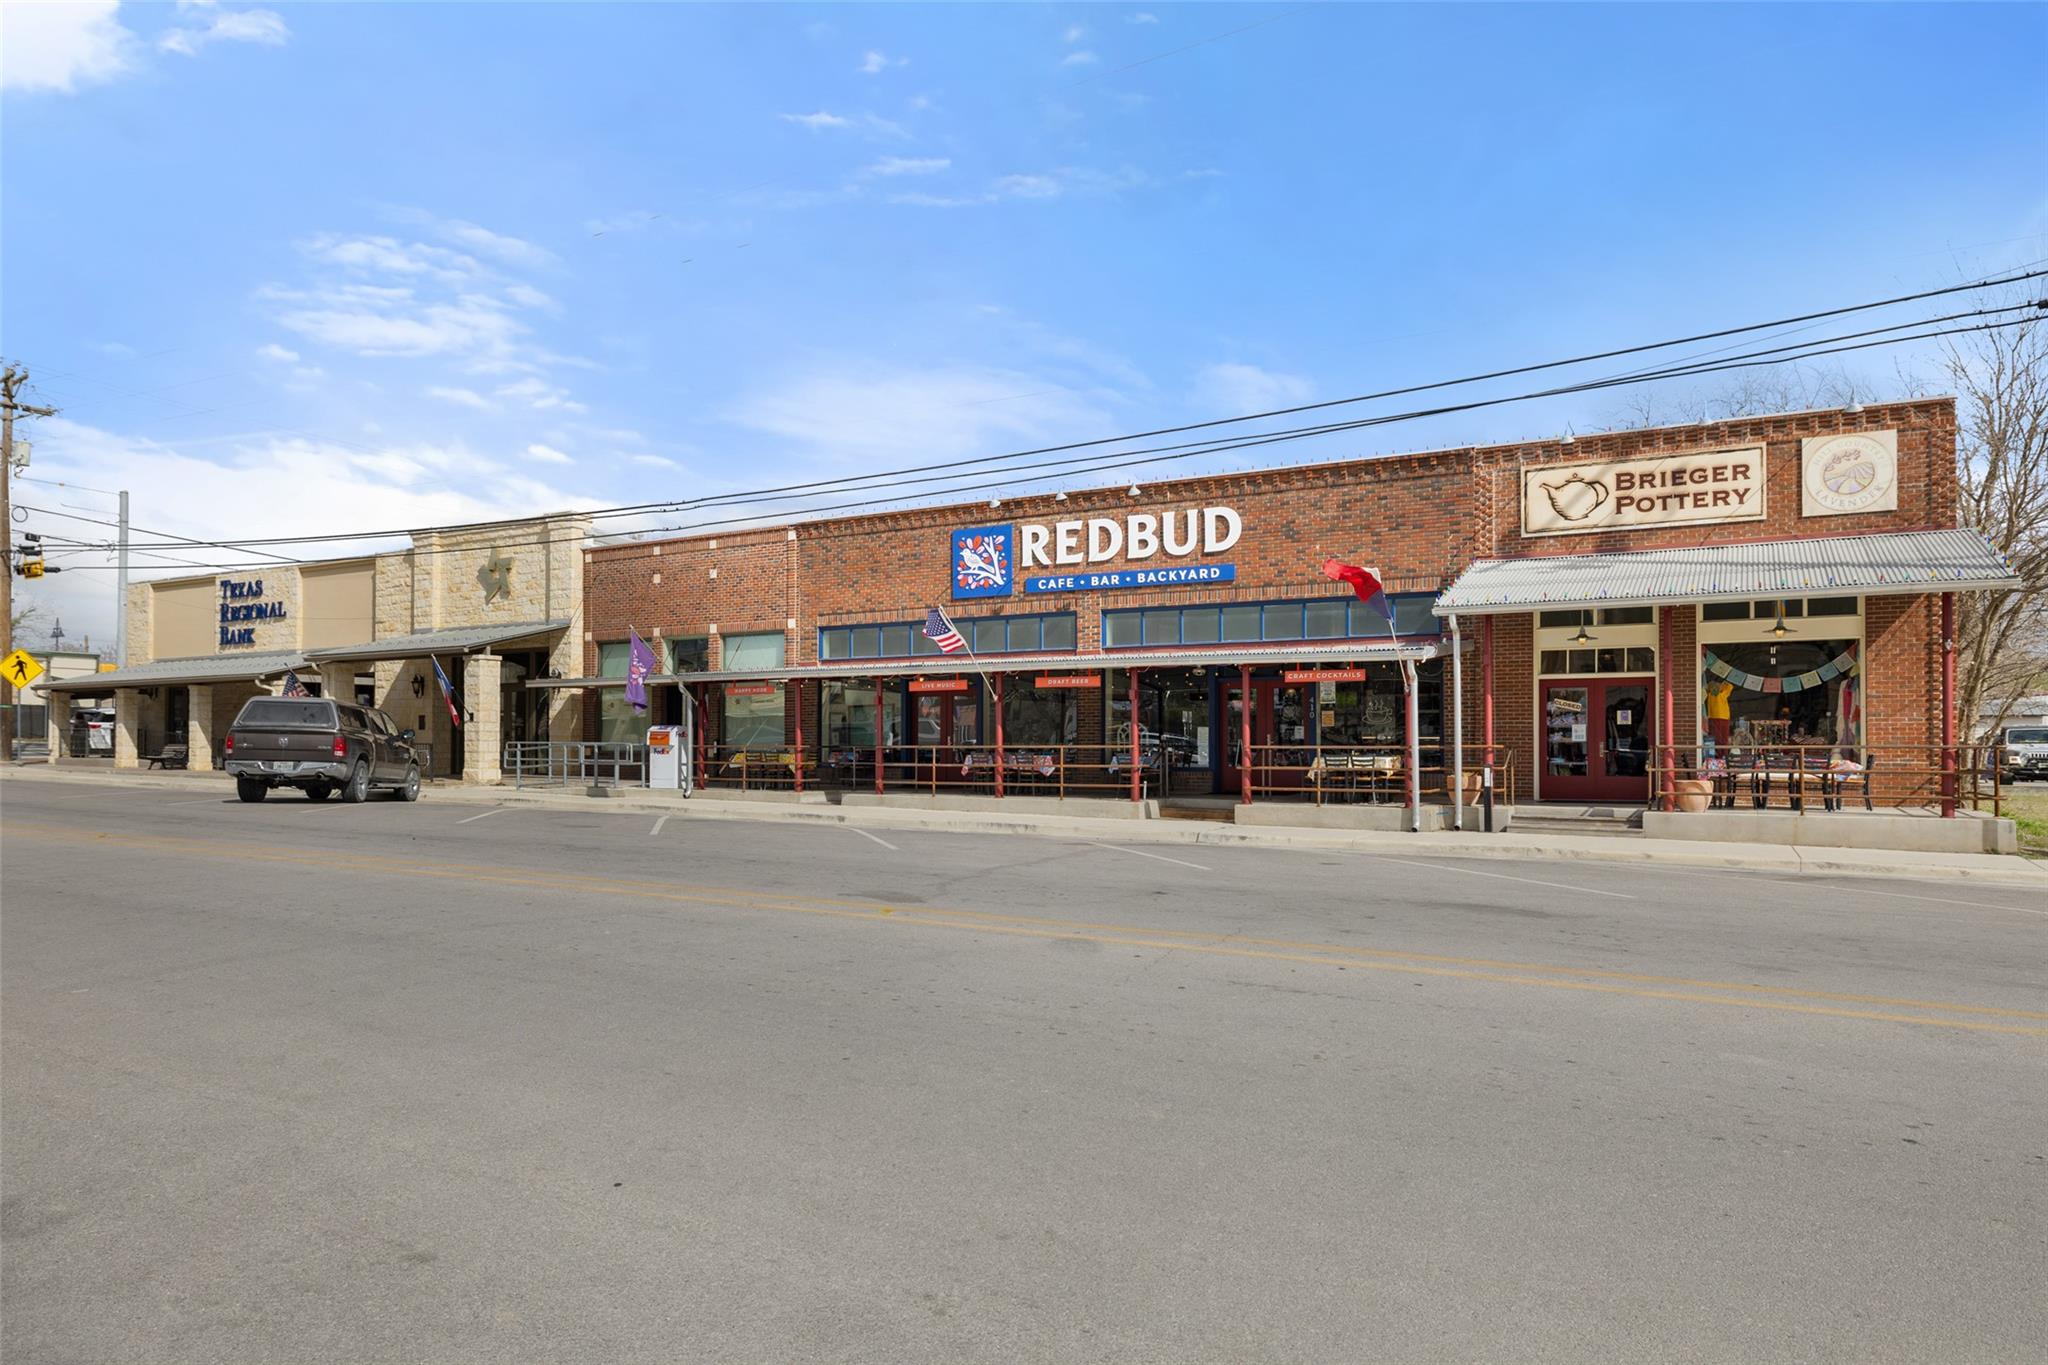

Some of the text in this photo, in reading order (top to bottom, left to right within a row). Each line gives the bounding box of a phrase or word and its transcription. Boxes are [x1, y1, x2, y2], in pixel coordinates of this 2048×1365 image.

[1615, 464, 1751, 491] BRIEGER
[1615, 488, 1751, 515] POTTERY
[1815, 484, 1884, 507] LAVENDER
[1021, 506, 1243, 567] REDBUD
[220, 580, 263, 599] TEXAS
[1038, 567, 1221, 590] CAFE BAR BACKYARD
[219, 601, 287, 622] REGIONAL
[219, 626, 255, 645] BANK
[1316, 671, 1362, 679] COCKTAILS
[1554, 699, 1581, 710] CLOSED
